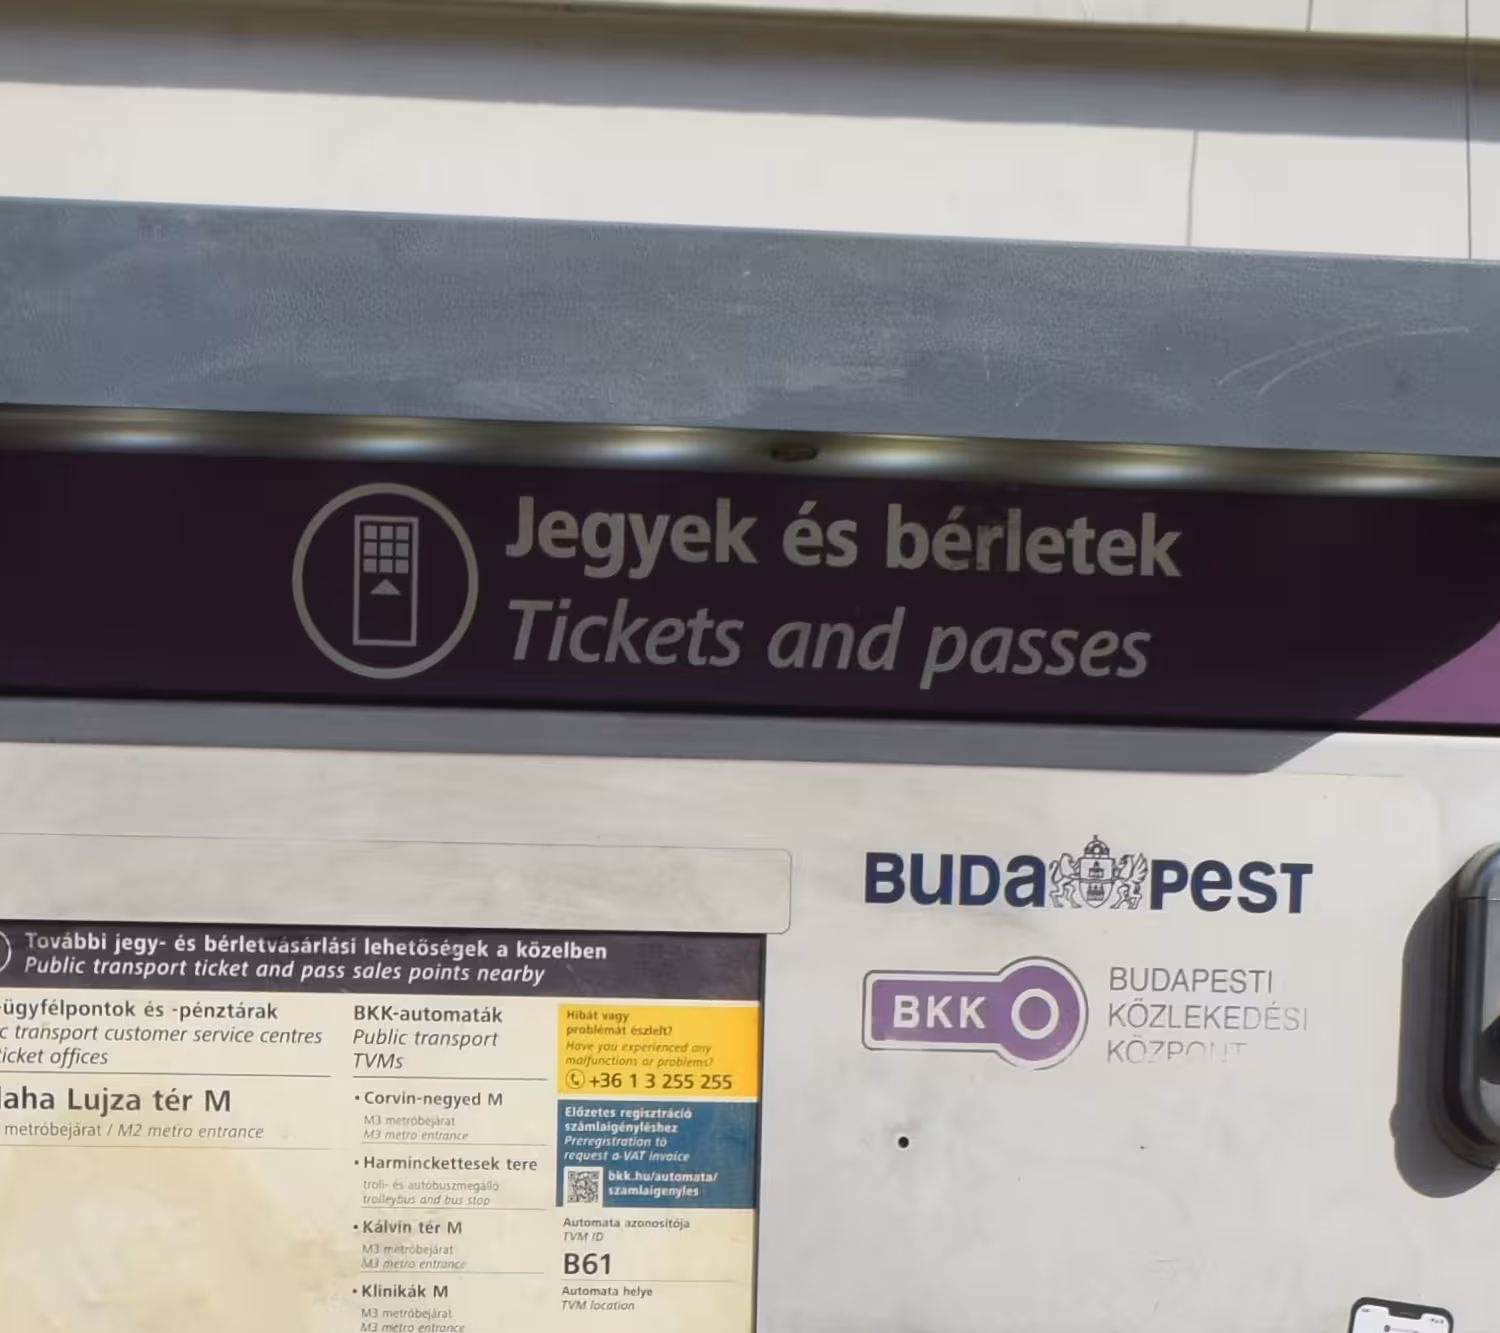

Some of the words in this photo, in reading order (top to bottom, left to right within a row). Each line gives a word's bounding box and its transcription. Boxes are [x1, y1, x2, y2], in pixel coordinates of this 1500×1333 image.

[505, 496, 758, 576] Jegyek
[782, 501, 858, 567] és
[886, 505, 1182, 575] bérletek
[508, 600, 744, 666] Tickets
[767, 607, 906, 670] and
[919, 626, 1151, 685] passes
[25, 932, 106, 950] További
[113, 933, 166, 955] jegy-
[174, 934, 196, 952] és
[204, 934, 356, 954] bérletvásárlási
[364, 937, 488, 961] lehetőségek
[496, 944, 508, 957] a
[516, 940, 607, 959] közelben
[24, 956, 86, 974] Public
[93, 959, 187, 978] transport
[194, 958, 249, 977] ticket
[255, 960, 294, 977] and
[300, 964, 345, 982] pass
[352, 962, 402, 979] sales
[408, 963, 470, 984] points
[476, 964, 545, 986] nearby
[1110, 967, 1273, 994] BUDAPESTI
[144, 1000, 164, 1017] és
[172, 1001, 278, 1021] -pénztárak
[354, 1005, 502, 1022] BKK-automaták
[893, 995, 987, 1029] BKK
[1108, 998, 1308, 1031] KÖZLEKEDÉSI
[14, 1025, 98, 1043] transport
[104, 1026, 188, 1041] customer
[192, 1026, 254, 1043] service
[260, 1029, 322, 1044] centres
[352, 1028, 408, 1045] Public
[414, 1031, 498, 1049] transport
[50, 1047, 108, 1069] offices
[353, 1052, 403, 1069] TVMs
[589, 1072, 622, 1088] +36
[629, 1072, 636, 1088] 1
[644, 1072, 656, 1089] 3
[662, 1073, 694, 1089] 255
[700, 1074, 732, 1089] 255
[68, 1087, 140, 1115] Lujza
[152, 1087, 192, 1111] tér
[205, 1089, 230, 1112] M
[364, 1091, 481, 1109] Corvin-negyed
[488, 1092, 502, 1106] M
[4, 1121, 101, 1139] metróbejárat
[117, 1123, 142, 1137] M2
[147, 1125, 193, 1137] metro
[198, 1126, 264, 1138] entrance
[364, 1155, 500, 1170] Harminckettesek
[506, 1158, 537, 1171] tere
[608, 1170, 718, 1182] bkk.hu/automata/
[363, 1219, 412, 1233] Kálvin
[418, 1220, 440, 1234] tér
[447, 1221, 462, 1234] M
[564, 1231, 588, 1241] TVM
[592, 1231, 604, 1241] ID
[564, 1252, 610, 1274] B61
[362, 1284, 426, 1297] Klinikák
[433, 1284, 448, 1298] M
[562, 1286, 618, 1296] Automata
[623, 1285, 653, 1299] helye
[562, 1299, 587, 1309] TVM
[590, 1300, 634, 1310] location
